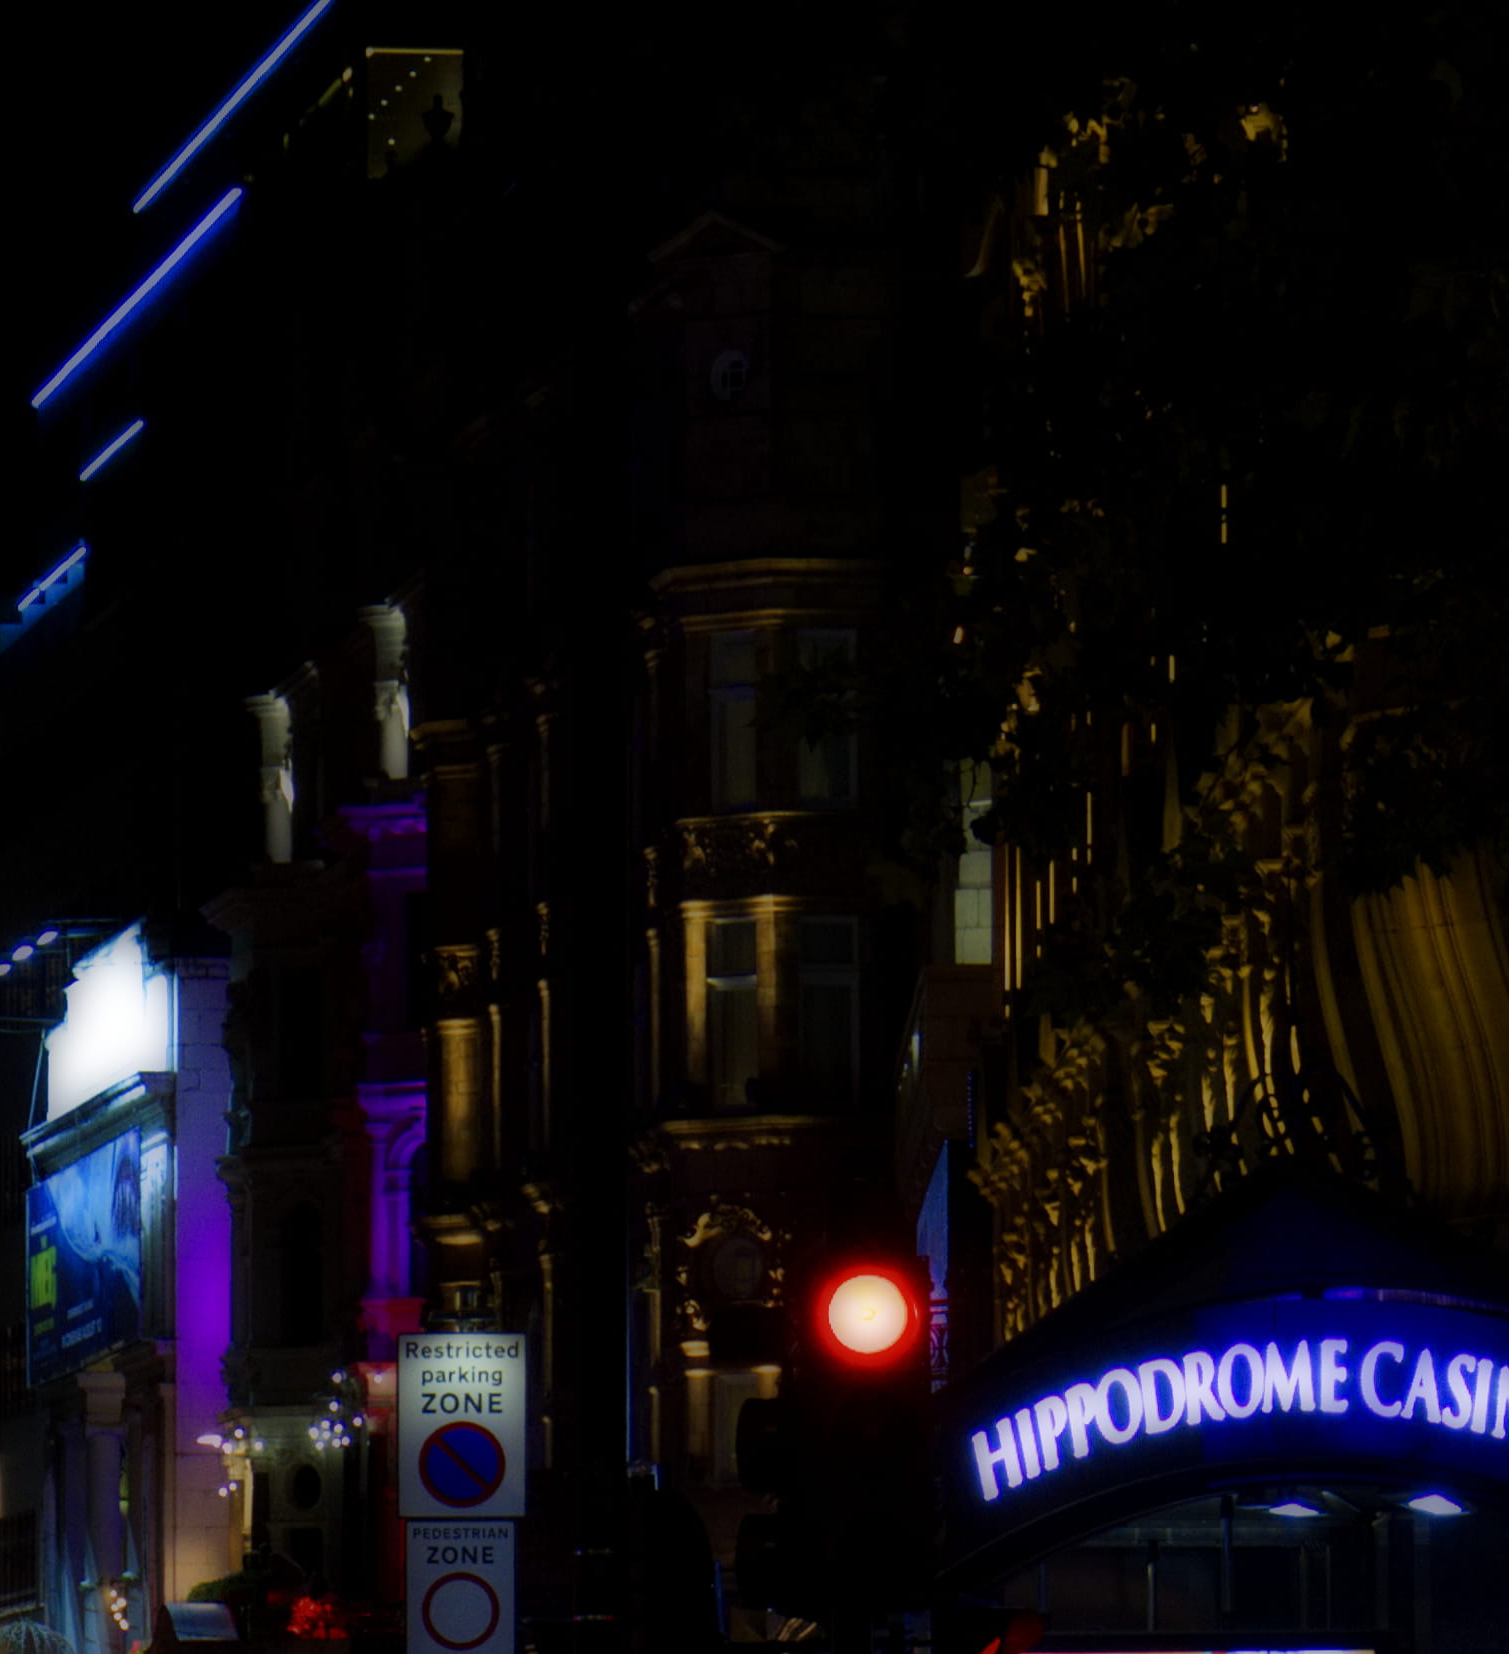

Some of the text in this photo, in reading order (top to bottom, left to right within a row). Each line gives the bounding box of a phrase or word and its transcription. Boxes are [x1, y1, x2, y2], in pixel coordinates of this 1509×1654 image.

[405, 1342, 519, 1359] Restricted
[422, 1366, 503, 1386] parking
[422, 1393, 503, 1414] ZONE
[971, 1338, 1349, 1502] HIPPODROME
[413, 1528, 509, 1539] PEDESTRIAN
[427, 1546, 494, 1564] ZONE
